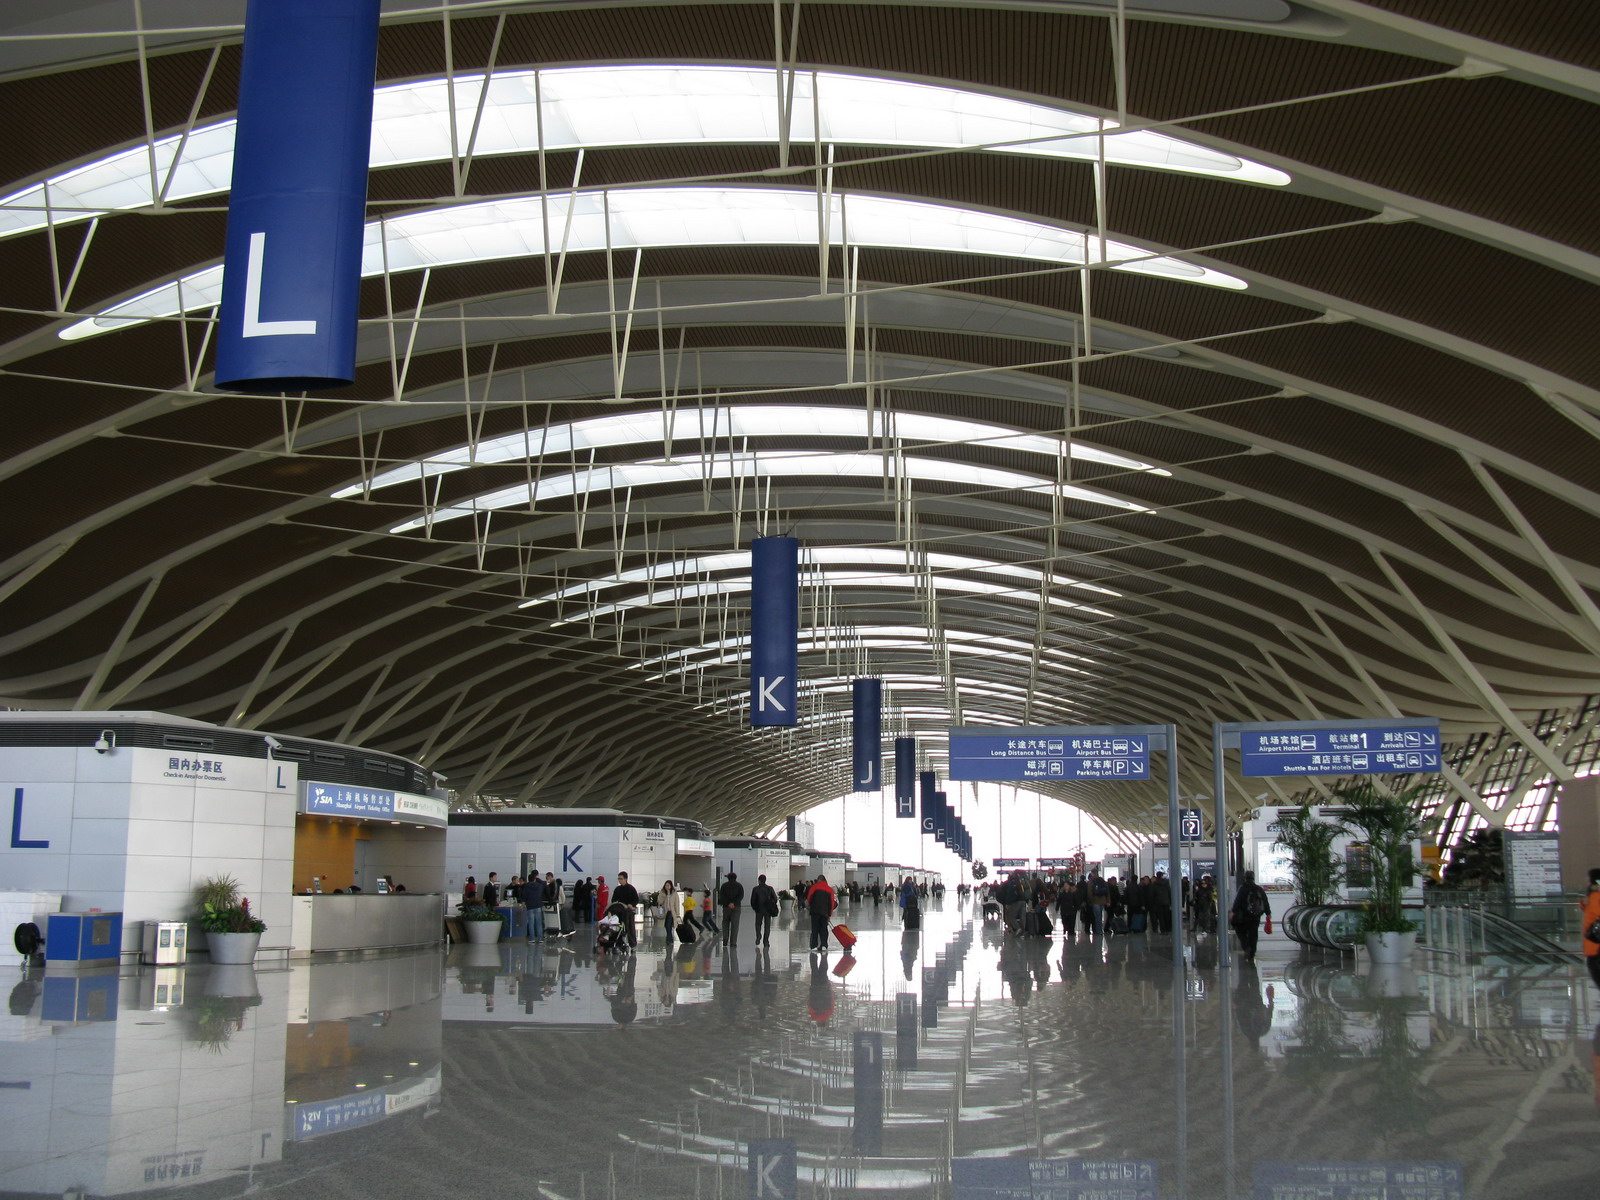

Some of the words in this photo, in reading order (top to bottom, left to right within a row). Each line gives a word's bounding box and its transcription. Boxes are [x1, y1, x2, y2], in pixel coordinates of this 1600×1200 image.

[243, 232, 316, 338] L
[759, 676, 786, 711] K
[1260, 736, 1299, 745] 机场宾馆
[1329, 734, 1359, 743] 航站楼
[1360, 733, 1368, 748] 1
[1383, 733, 1403, 742] 到达
[1007, 740, 1047, 749] 长途汽车
[1072, 740, 1111, 749] 机场巴士
[1312, 755, 1351, 765] 酒店班车
[1376, 753, 1405, 763] 出租车
[168, 757, 223, 773] 国内办票区
[1027, 760, 1047, 769] 磁浮
[1082, 760, 1112, 769] 停车库
[277, 766, 286, 789] L
[861, 761, 873, 784] J
[900, 797, 912, 813] H
[11, 788, 49, 848] L
[923, 817, 934, 830] G
[623, 830, 629, 841] K
[937, 829, 944, 839] F
[946, 837, 953, 847] E
[953, 843, 960, 852] D
[563, 845, 583, 872] K
